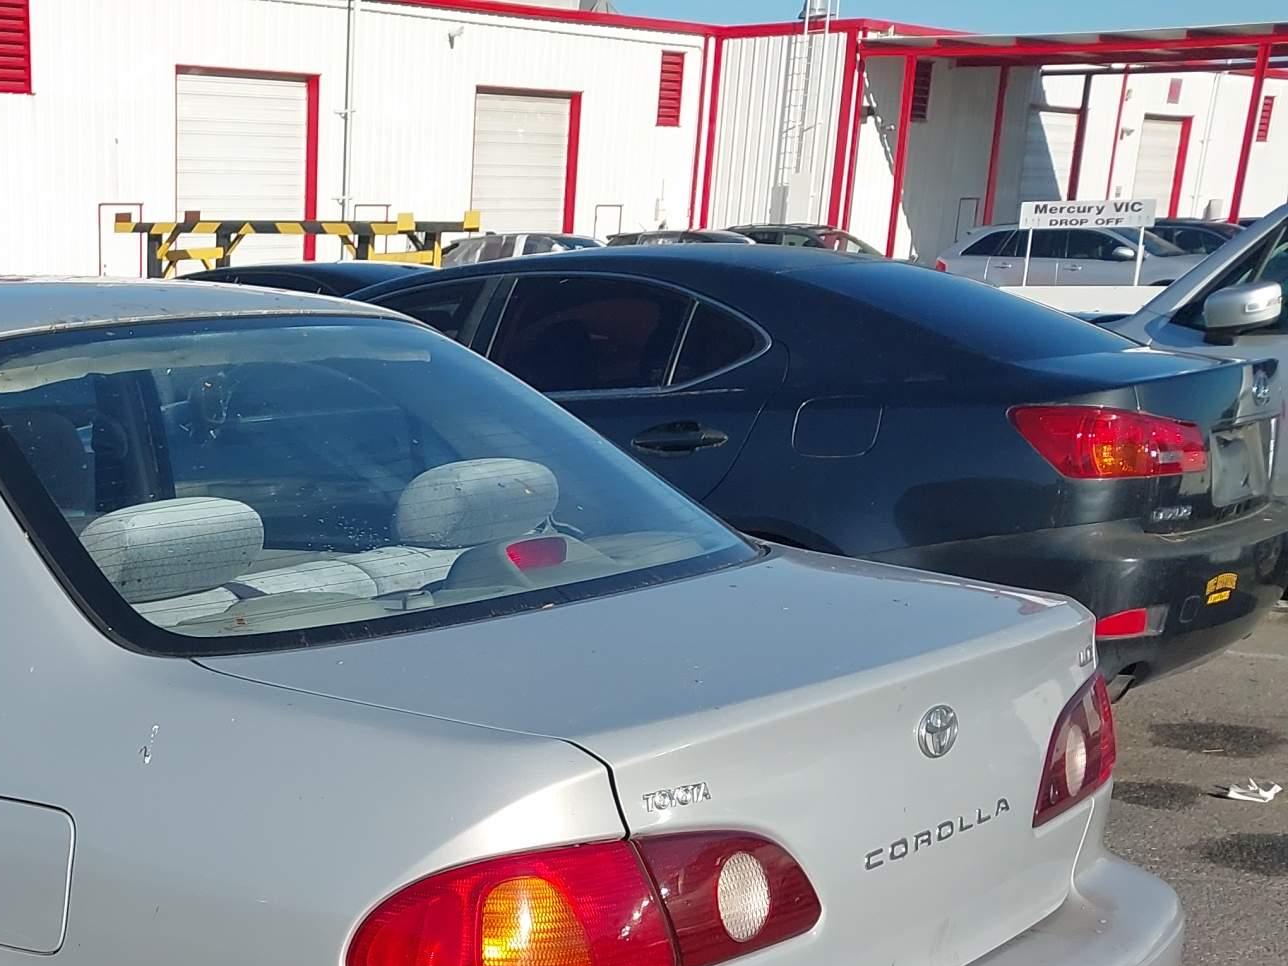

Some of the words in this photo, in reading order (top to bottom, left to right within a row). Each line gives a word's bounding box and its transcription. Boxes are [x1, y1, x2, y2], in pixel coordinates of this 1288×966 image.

[1034, 203, 1105, 216] Mercury
[1114, 201, 1143, 213] VIC
[1048, 218, 1089, 227] DROP
[1095, 217, 1125, 226] OFF
[642, 781, 712, 813] TOYOTA
[864, 797, 1011, 871] COROLLA
